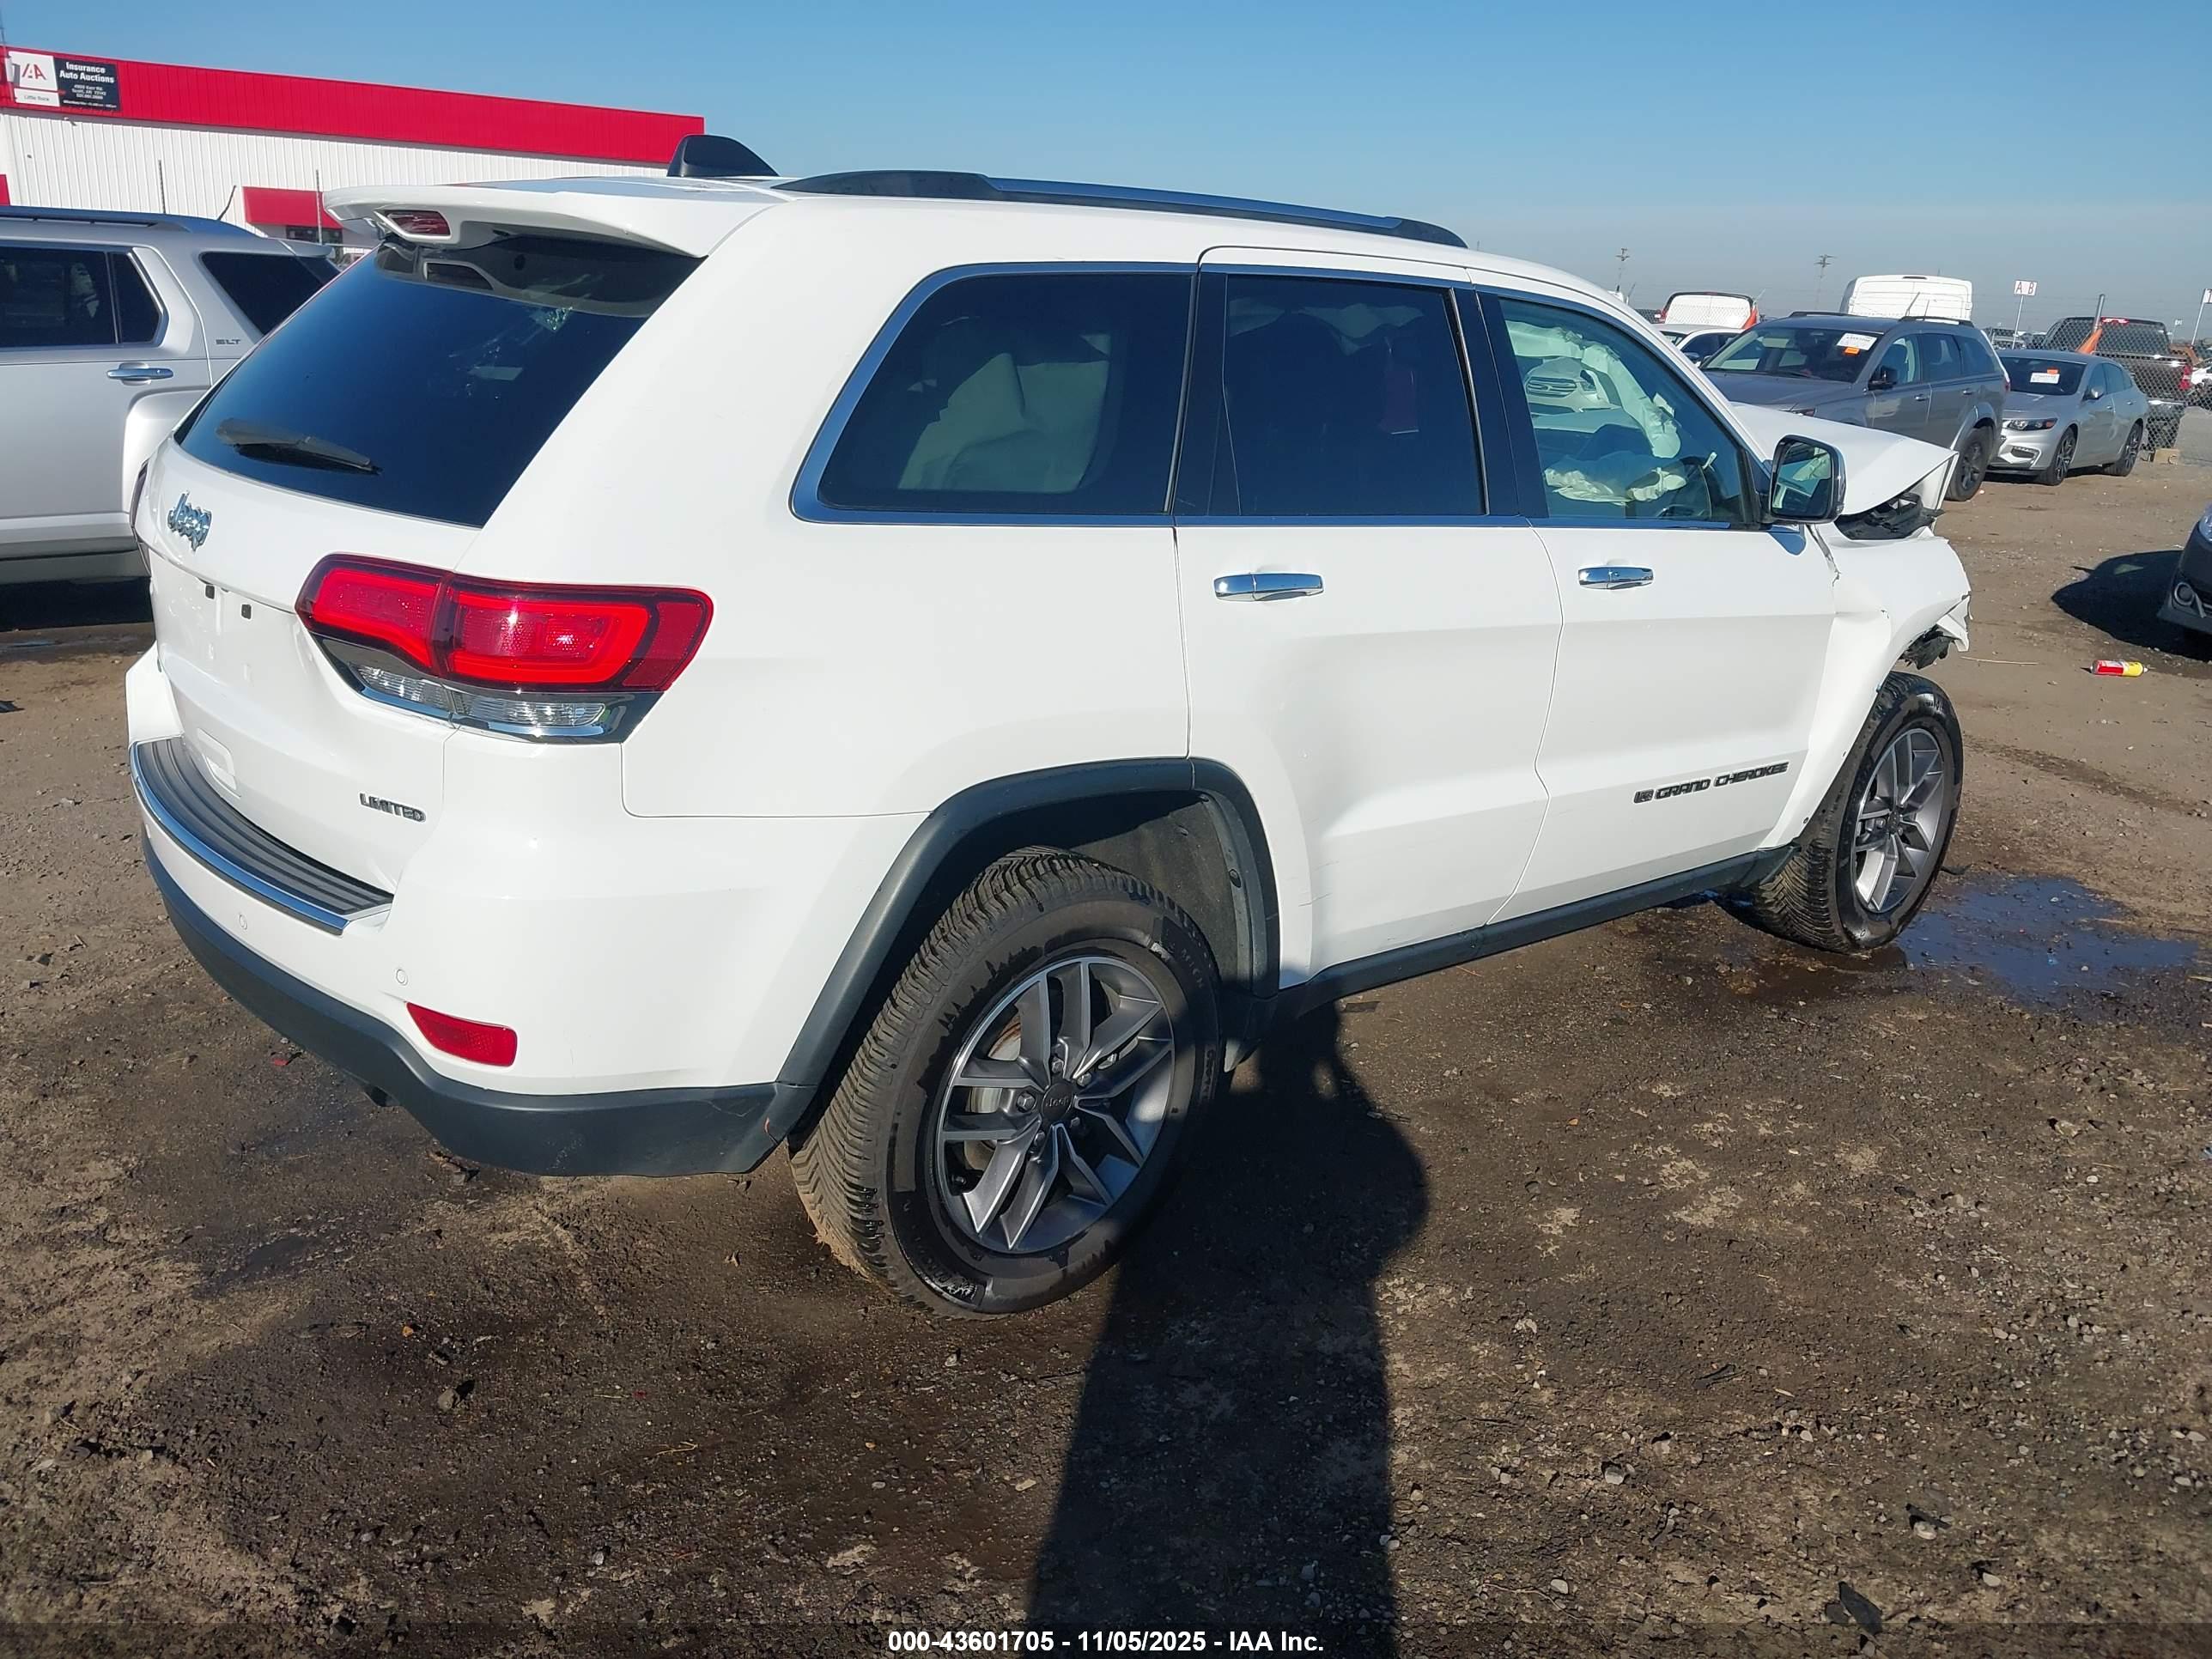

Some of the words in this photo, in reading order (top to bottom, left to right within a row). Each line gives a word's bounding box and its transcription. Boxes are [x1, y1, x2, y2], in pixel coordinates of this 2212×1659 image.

[59, 70, 78, 80] Auto
[79, 72, 114, 83] Auctions
[65, 62, 106, 74] Insurance
[2015, 281, 2022, 294] A
[2027, 282, 2035, 295] B
[167, 490, 212, 551] Jeep
[1655, 778, 1711, 799] GRAND
[1713, 762, 1790, 787] CHEROKEE
[359, 792, 426, 823] LIMITED
